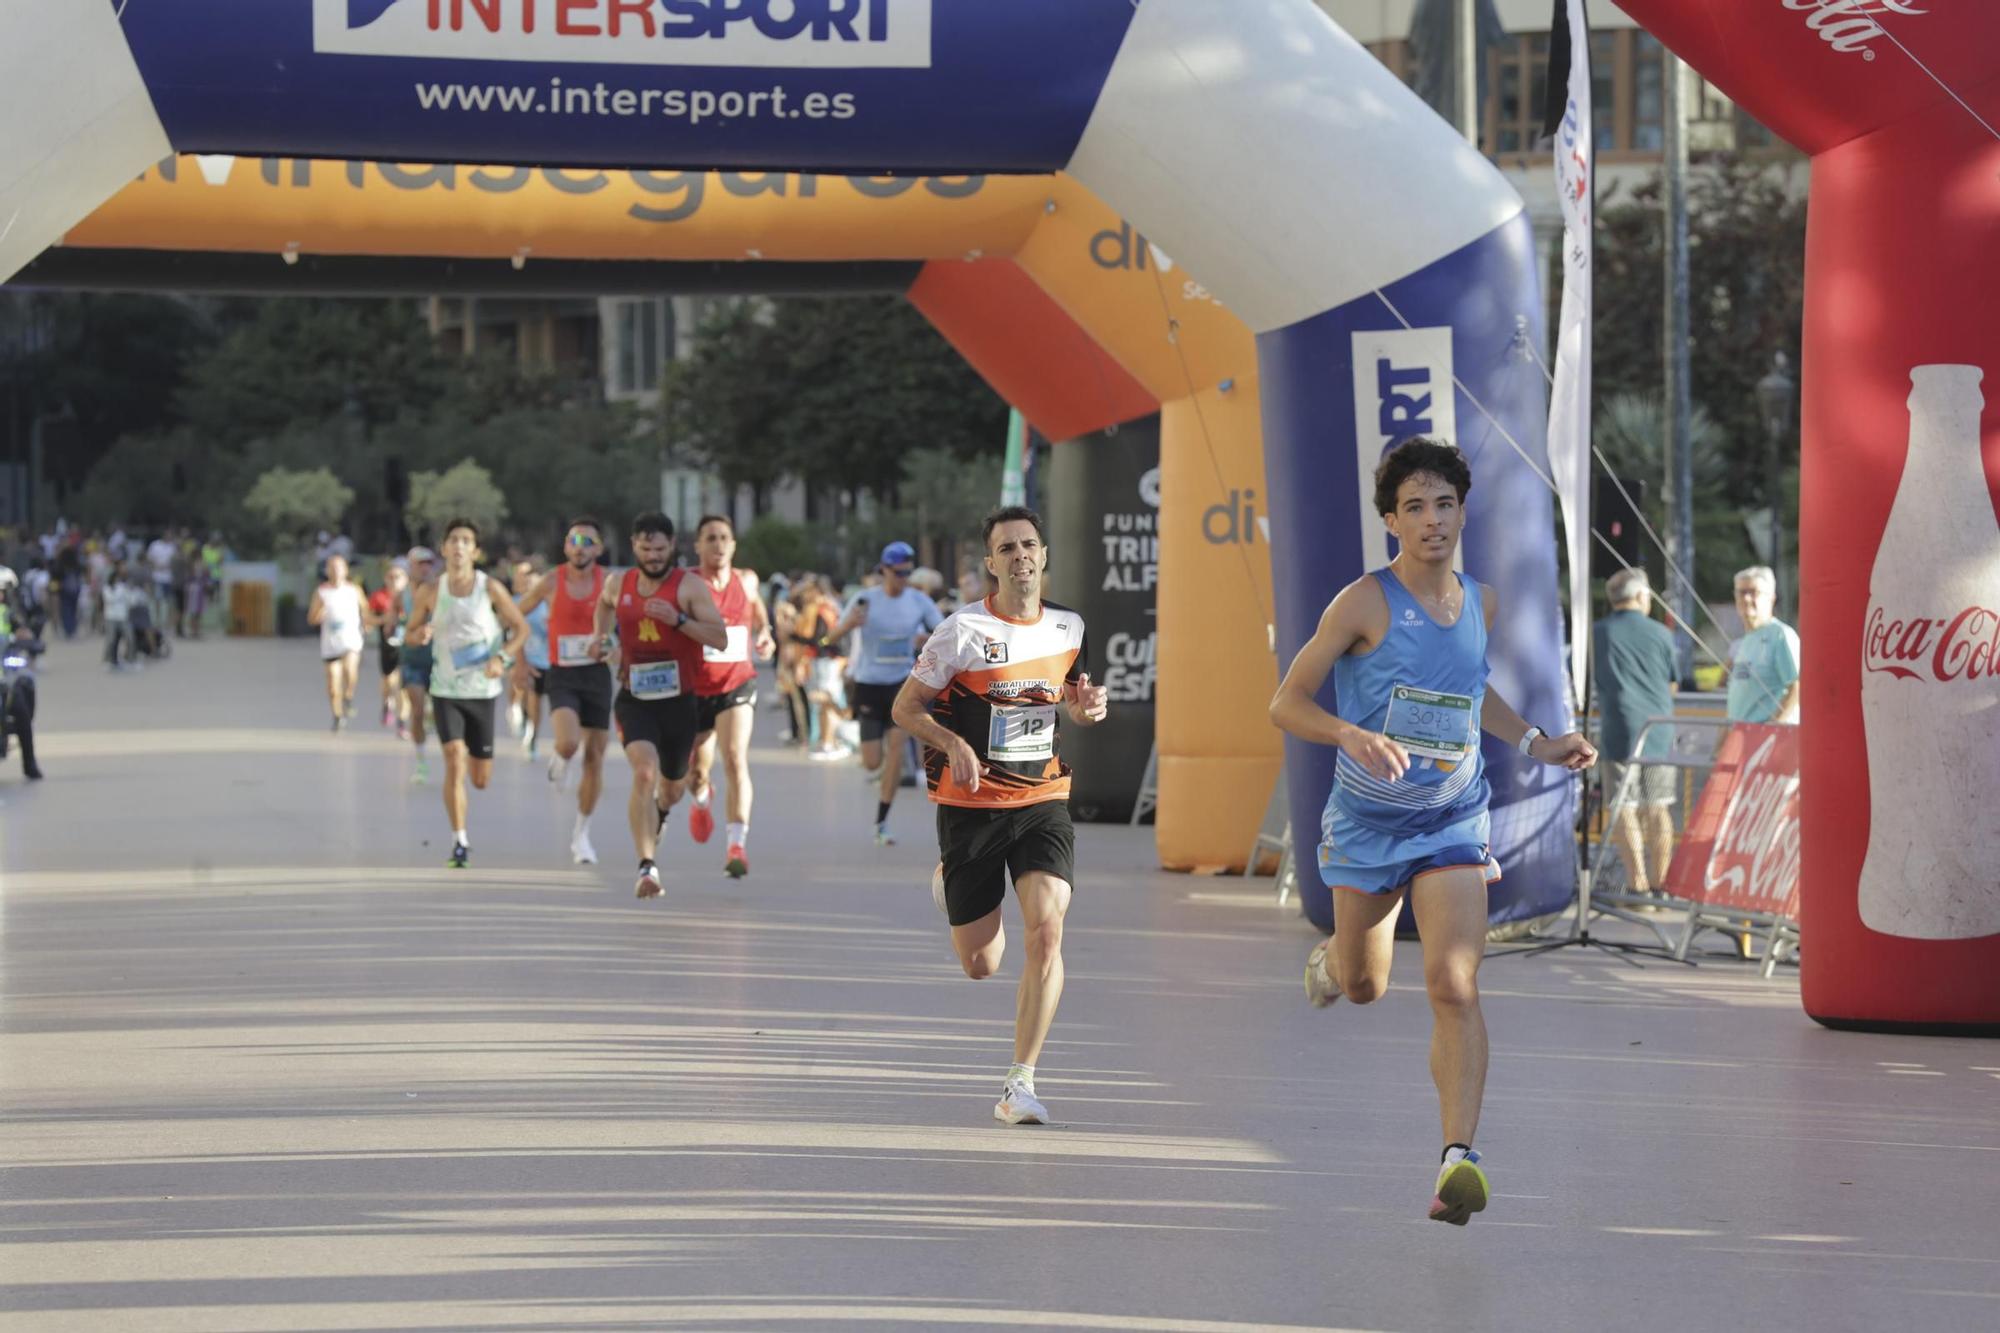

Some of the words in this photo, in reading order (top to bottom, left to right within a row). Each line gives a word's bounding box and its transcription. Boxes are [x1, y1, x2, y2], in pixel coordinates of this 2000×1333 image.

[415, 77, 856, 123] www.intersport.es
[1021, 718, 1044, 736] 12
[1407, 705, 1452, 732] 3073
